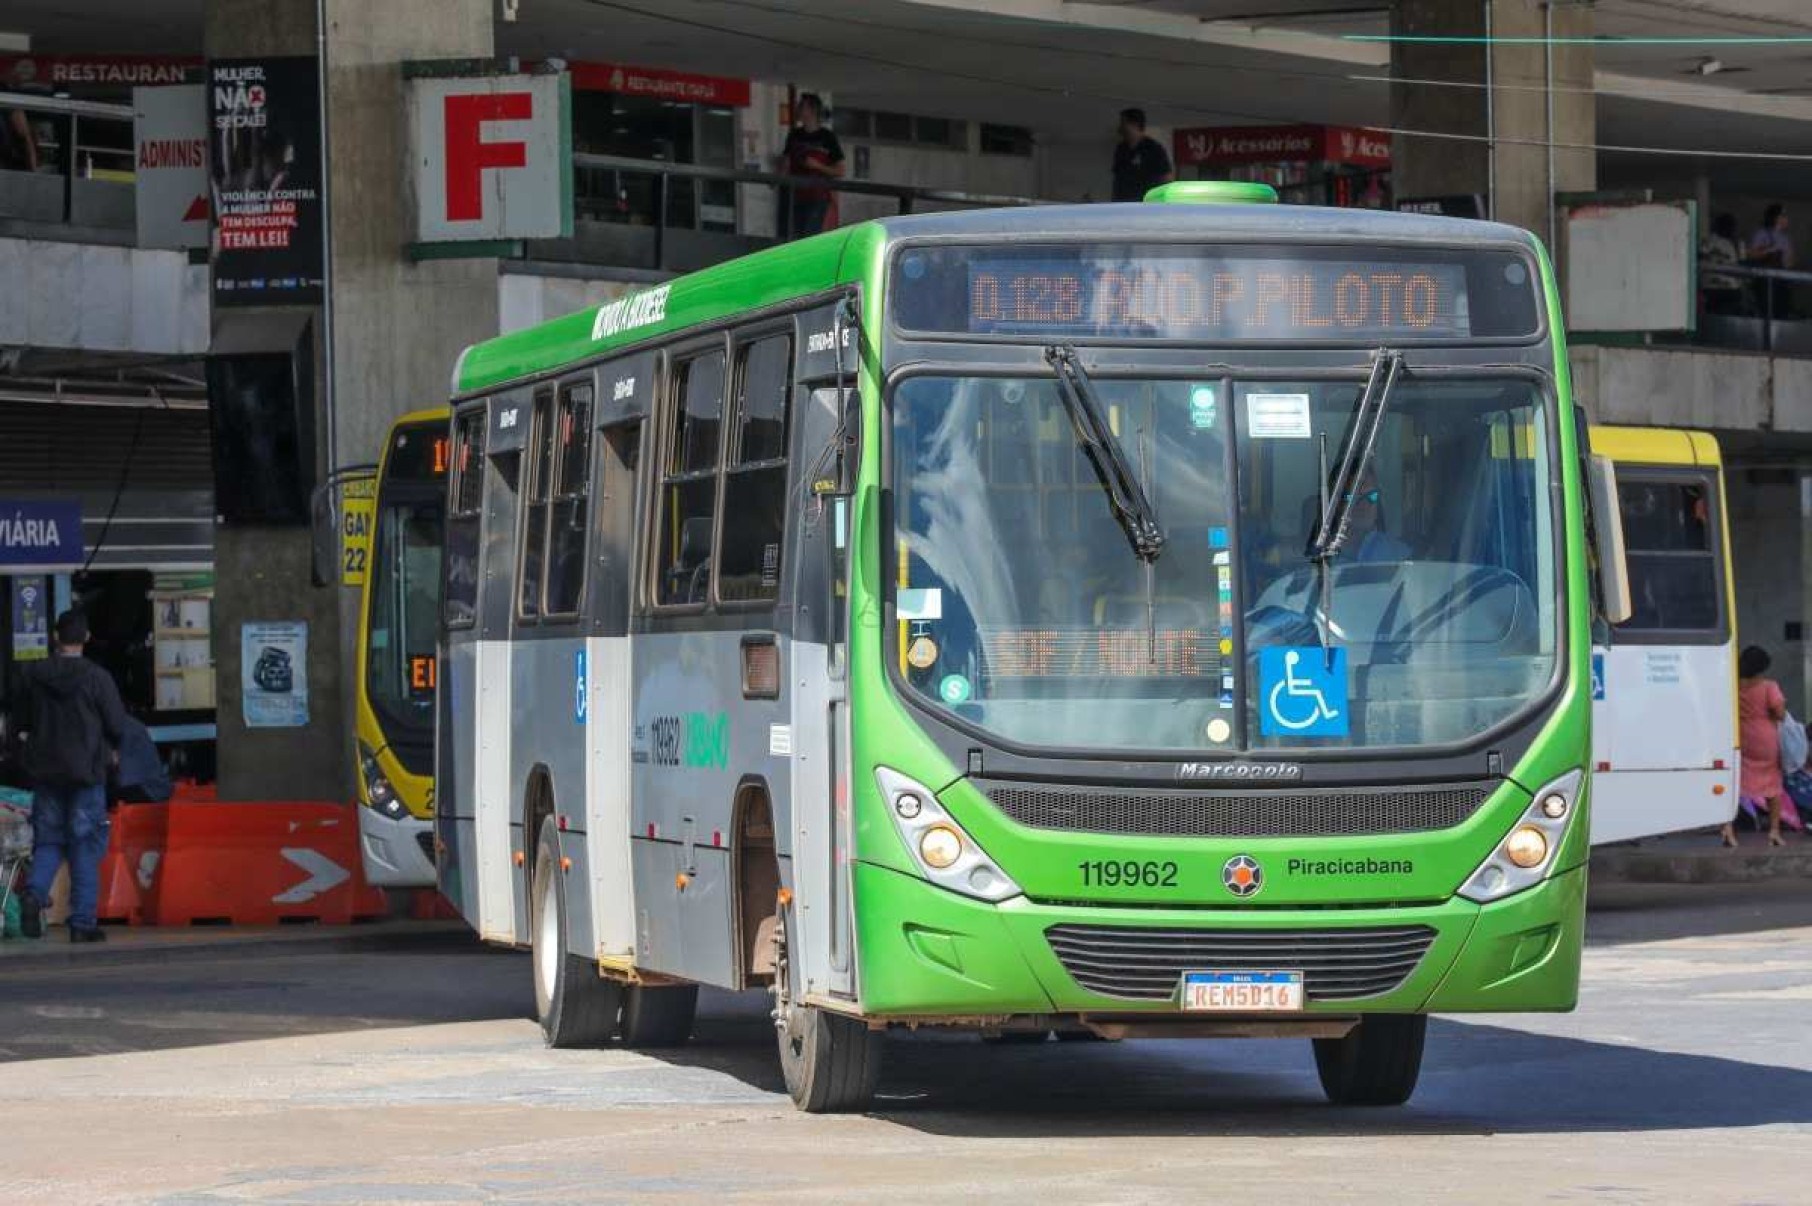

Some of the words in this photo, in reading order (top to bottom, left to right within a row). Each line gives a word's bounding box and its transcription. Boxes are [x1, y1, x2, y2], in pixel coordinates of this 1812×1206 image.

[215, 81, 266, 110] NÃO
[444, 92, 532, 222] F
[222, 231, 256, 247] TEM
[345, 547, 365, 572] 22
[1078, 861, 1179, 887] 119962
[1288, 858, 1413, 876] Piracicabana
[1195, 985, 1290, 1006] REM5D16
